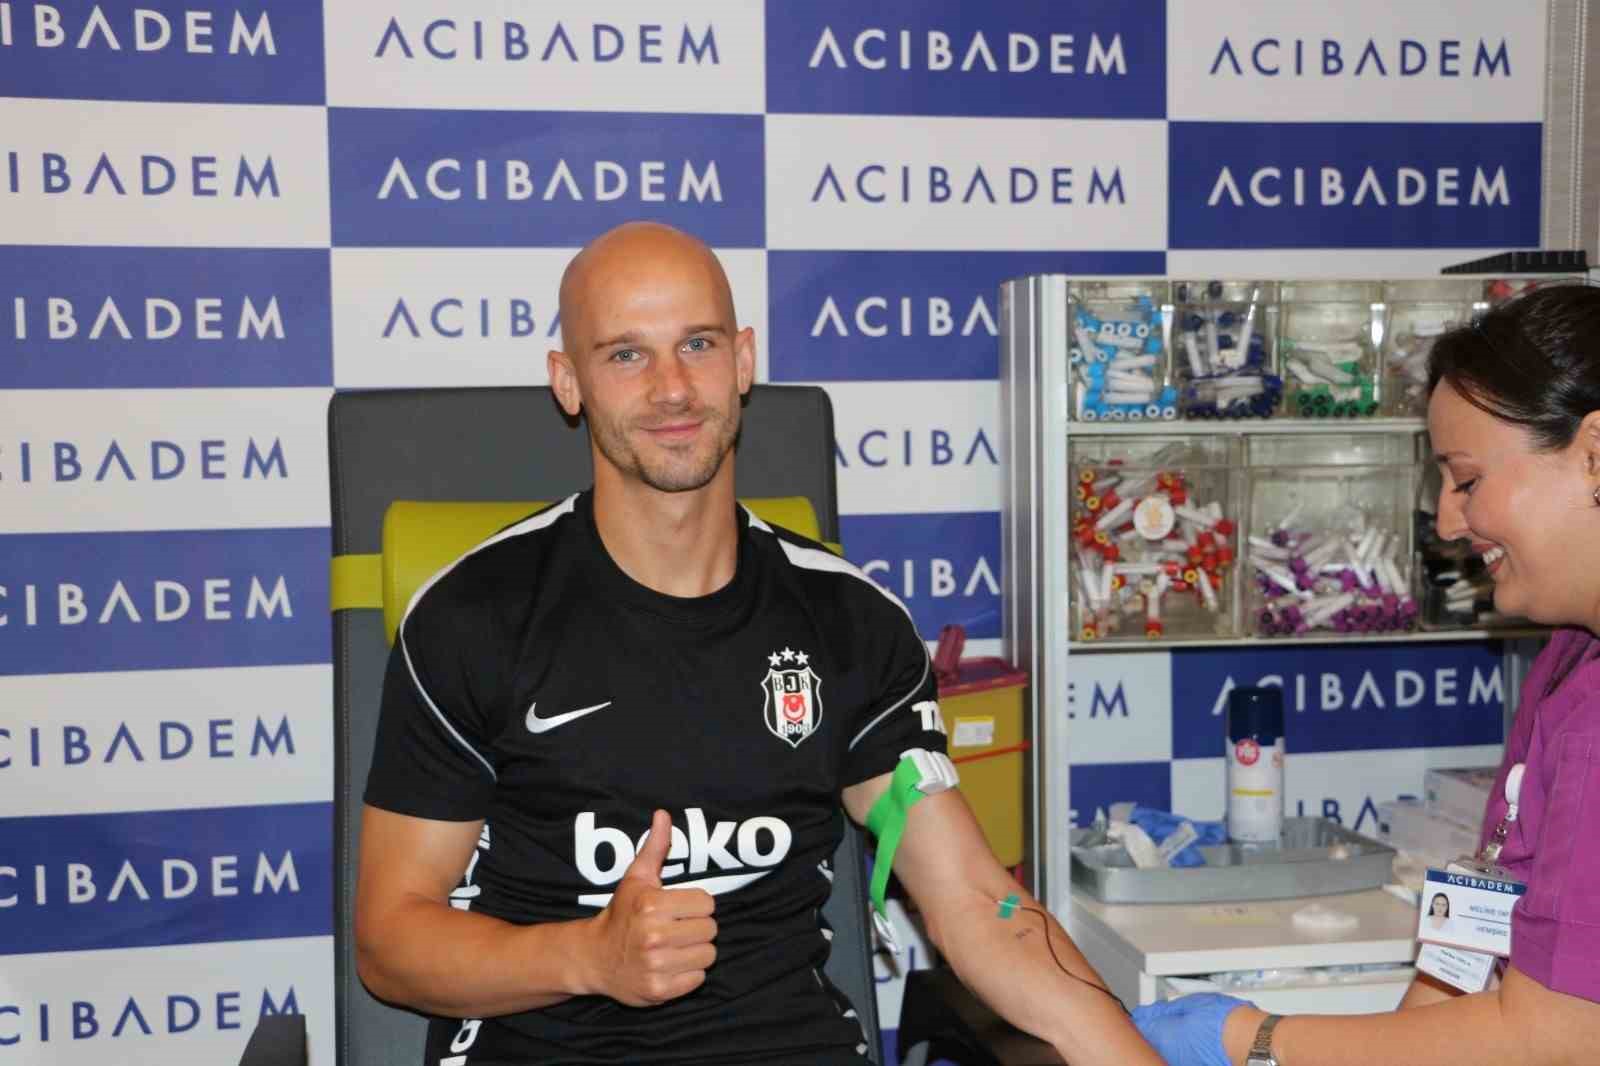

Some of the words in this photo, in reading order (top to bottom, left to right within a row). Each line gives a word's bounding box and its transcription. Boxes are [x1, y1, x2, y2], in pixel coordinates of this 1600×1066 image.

[374, 16, 720, 65] ACIBADEM
[808, 27, 1127, 75] ACIBADEM
[1209, 37, 1511, 77] ACIBADEM
[377, 157, 723, 203] ACIBADEM
[811, 163, 1126, 204] ACIBADEM
[1207, 166, 1510, 207] ACIBADEM
[0, 437, 289, 483] IBADEM
[0, 575, 293, 627] IBADEM
[1211, 665, 1507, 716] AIBADEM
[575, 807, 792, 885] beko
[1447, 874, 1514, 893] ACIBADEM
